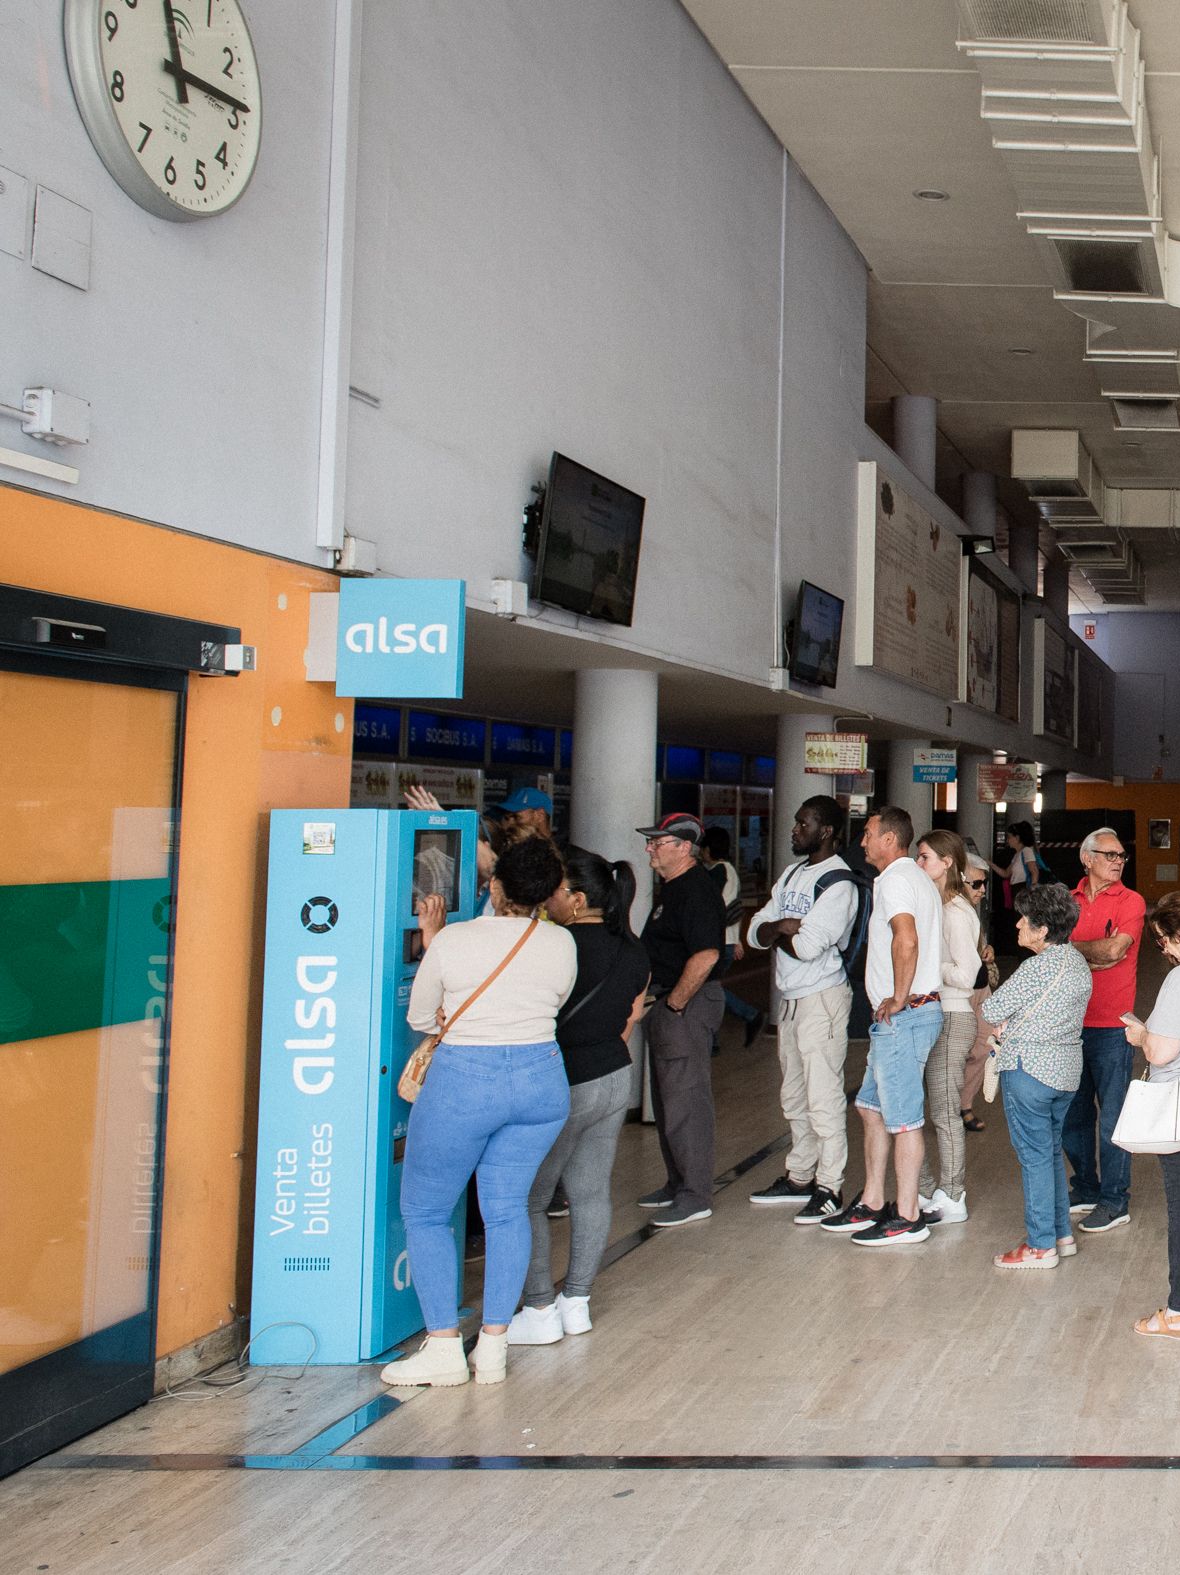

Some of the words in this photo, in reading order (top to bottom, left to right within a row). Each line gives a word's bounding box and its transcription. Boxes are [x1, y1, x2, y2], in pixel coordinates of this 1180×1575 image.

[104, 10, 118, 41] 9
[222, 46, 234, 79] 2
[110, 69, 125, 102] 8
[138, 121, 152, 153] 7
[164, 156, 177, 185] 6
[214, 141, 228, 170] 4
[193, 158, 207, 191] 5
[346, 616, 448, 654] alsa
[284, 954, 338, 1095] alsa
[270, 1147, 298, 1236] Venta
[302, 1123, 333, 1235] billetes
